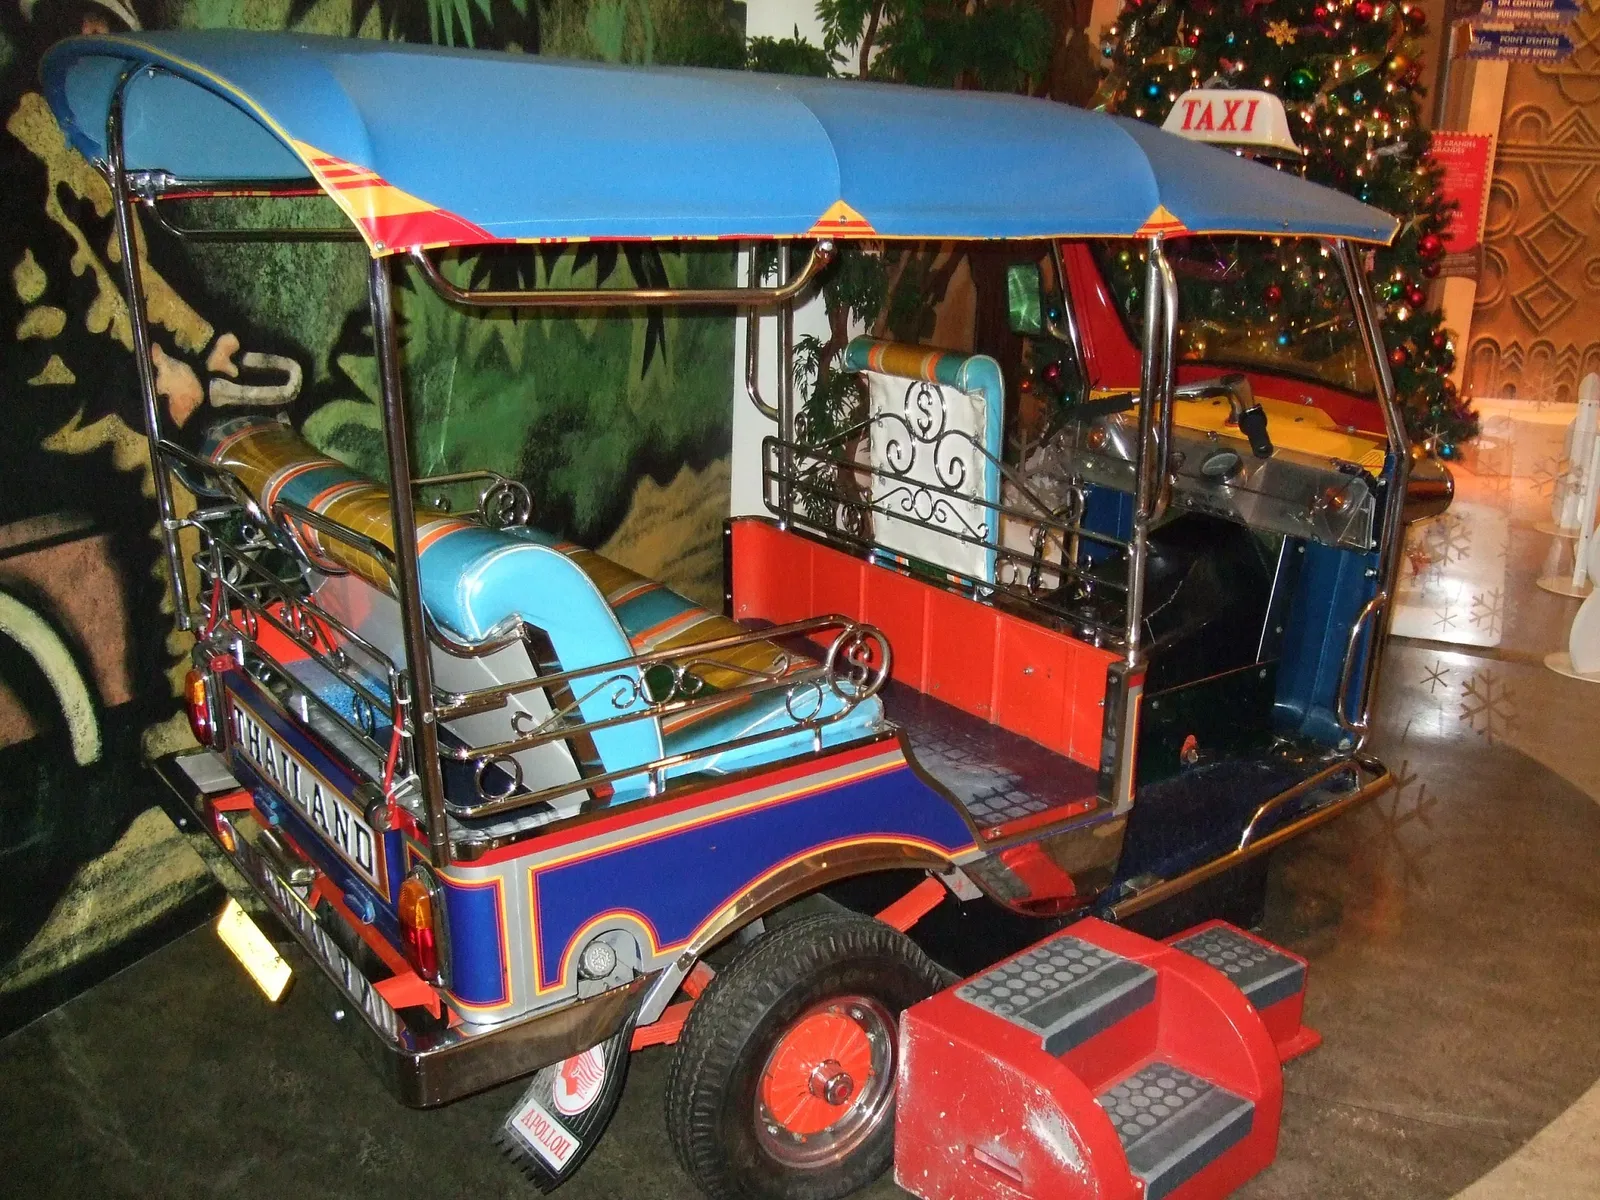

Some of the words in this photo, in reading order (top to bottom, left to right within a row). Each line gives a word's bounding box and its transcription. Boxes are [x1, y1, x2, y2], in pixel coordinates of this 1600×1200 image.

[1500, 35, 1523, 45] POINT
[1498, 46, 1519, 55] PORT
[1520, 47, 1531, 56] OF
[1533, 48, 1558, 57] ENTRY
[1181, 100, 1259, 131] TAXI
[233, 704, 373, 877] THAILAND
